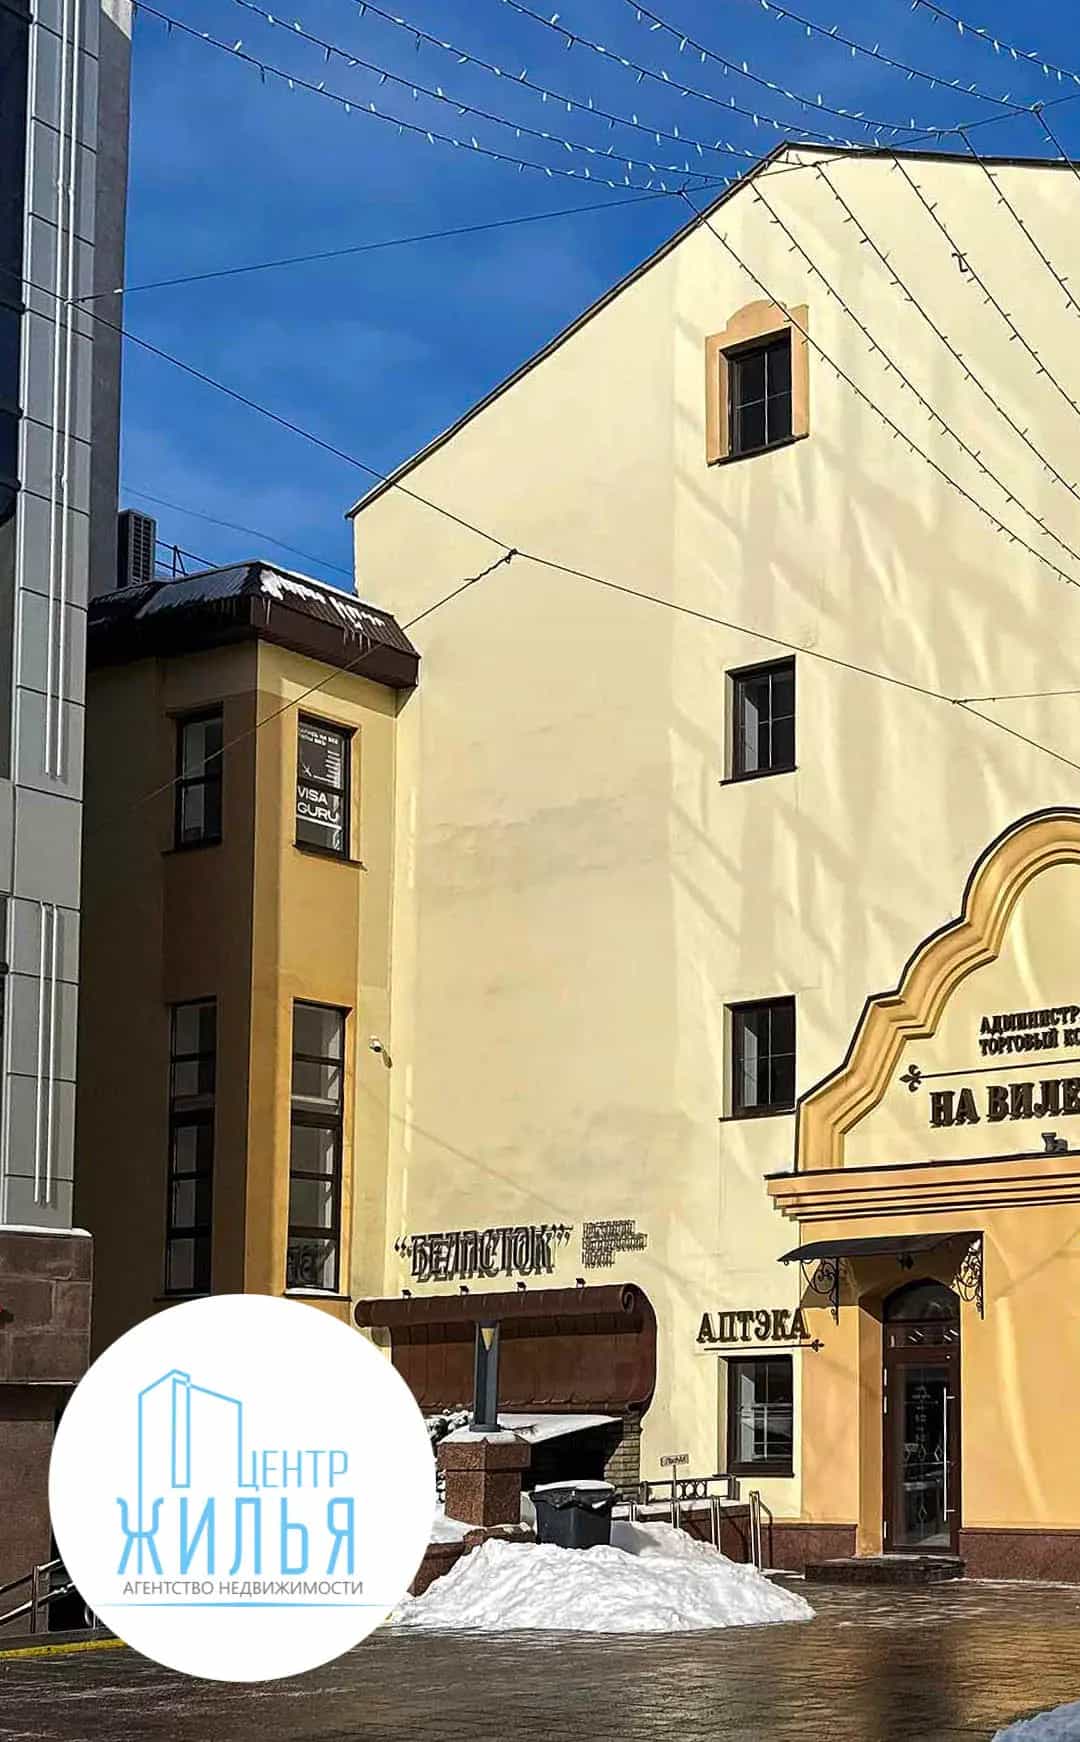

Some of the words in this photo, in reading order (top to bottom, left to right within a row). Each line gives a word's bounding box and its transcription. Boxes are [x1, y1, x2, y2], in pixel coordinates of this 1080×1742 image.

[298, 785, 328, 805] VISA
[298, 802, 340, 822] GURU
[979, 1028, 1059, 1056] ТОРГОВЫЙ
[930, 1087, 979, 1128] НА
[696, 1308, 811, 1343] АПТЭКА
